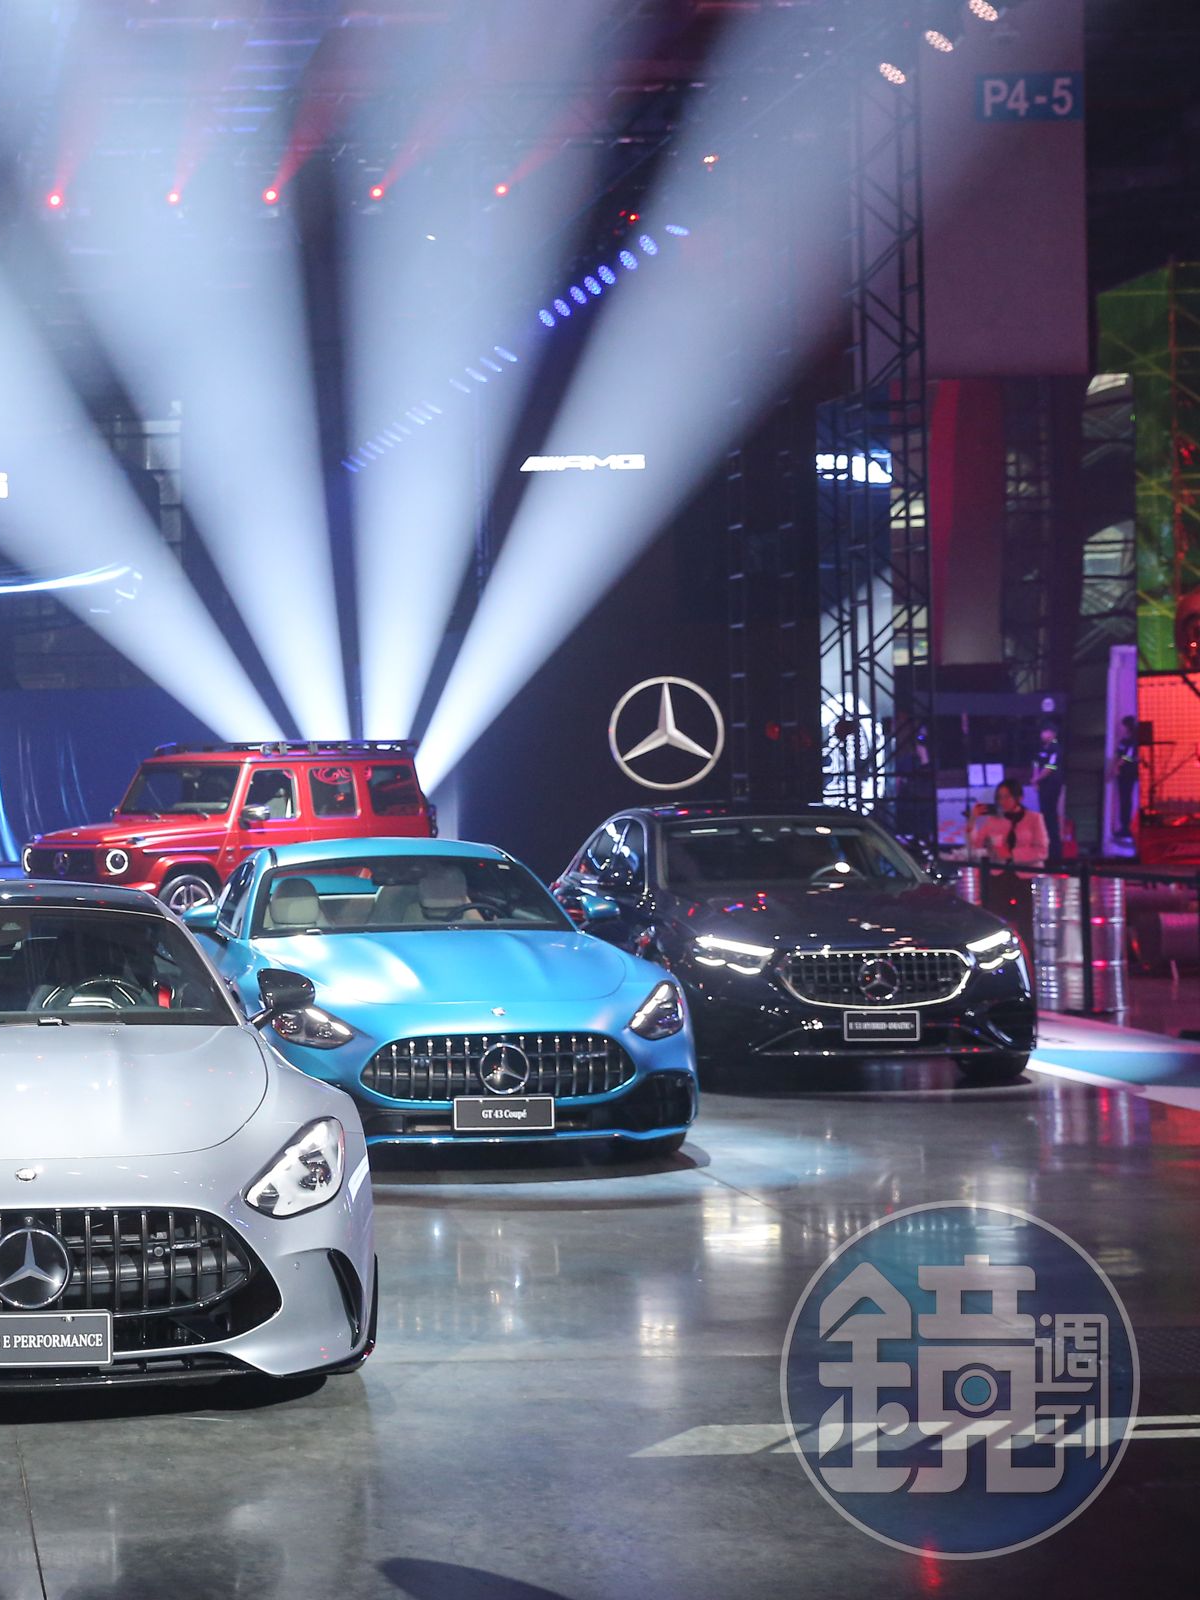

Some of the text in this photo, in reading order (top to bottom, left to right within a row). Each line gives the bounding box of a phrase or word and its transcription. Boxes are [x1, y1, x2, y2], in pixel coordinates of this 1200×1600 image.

[984, 77, 1073, 117] P4-5
[482, 1109, 493, 1119] GT
[504, 1108, 527, 1120] Coupé
[3, 1335, 11, 1348] E
[13, 1333, 103, 1348] PERFORMANCE
